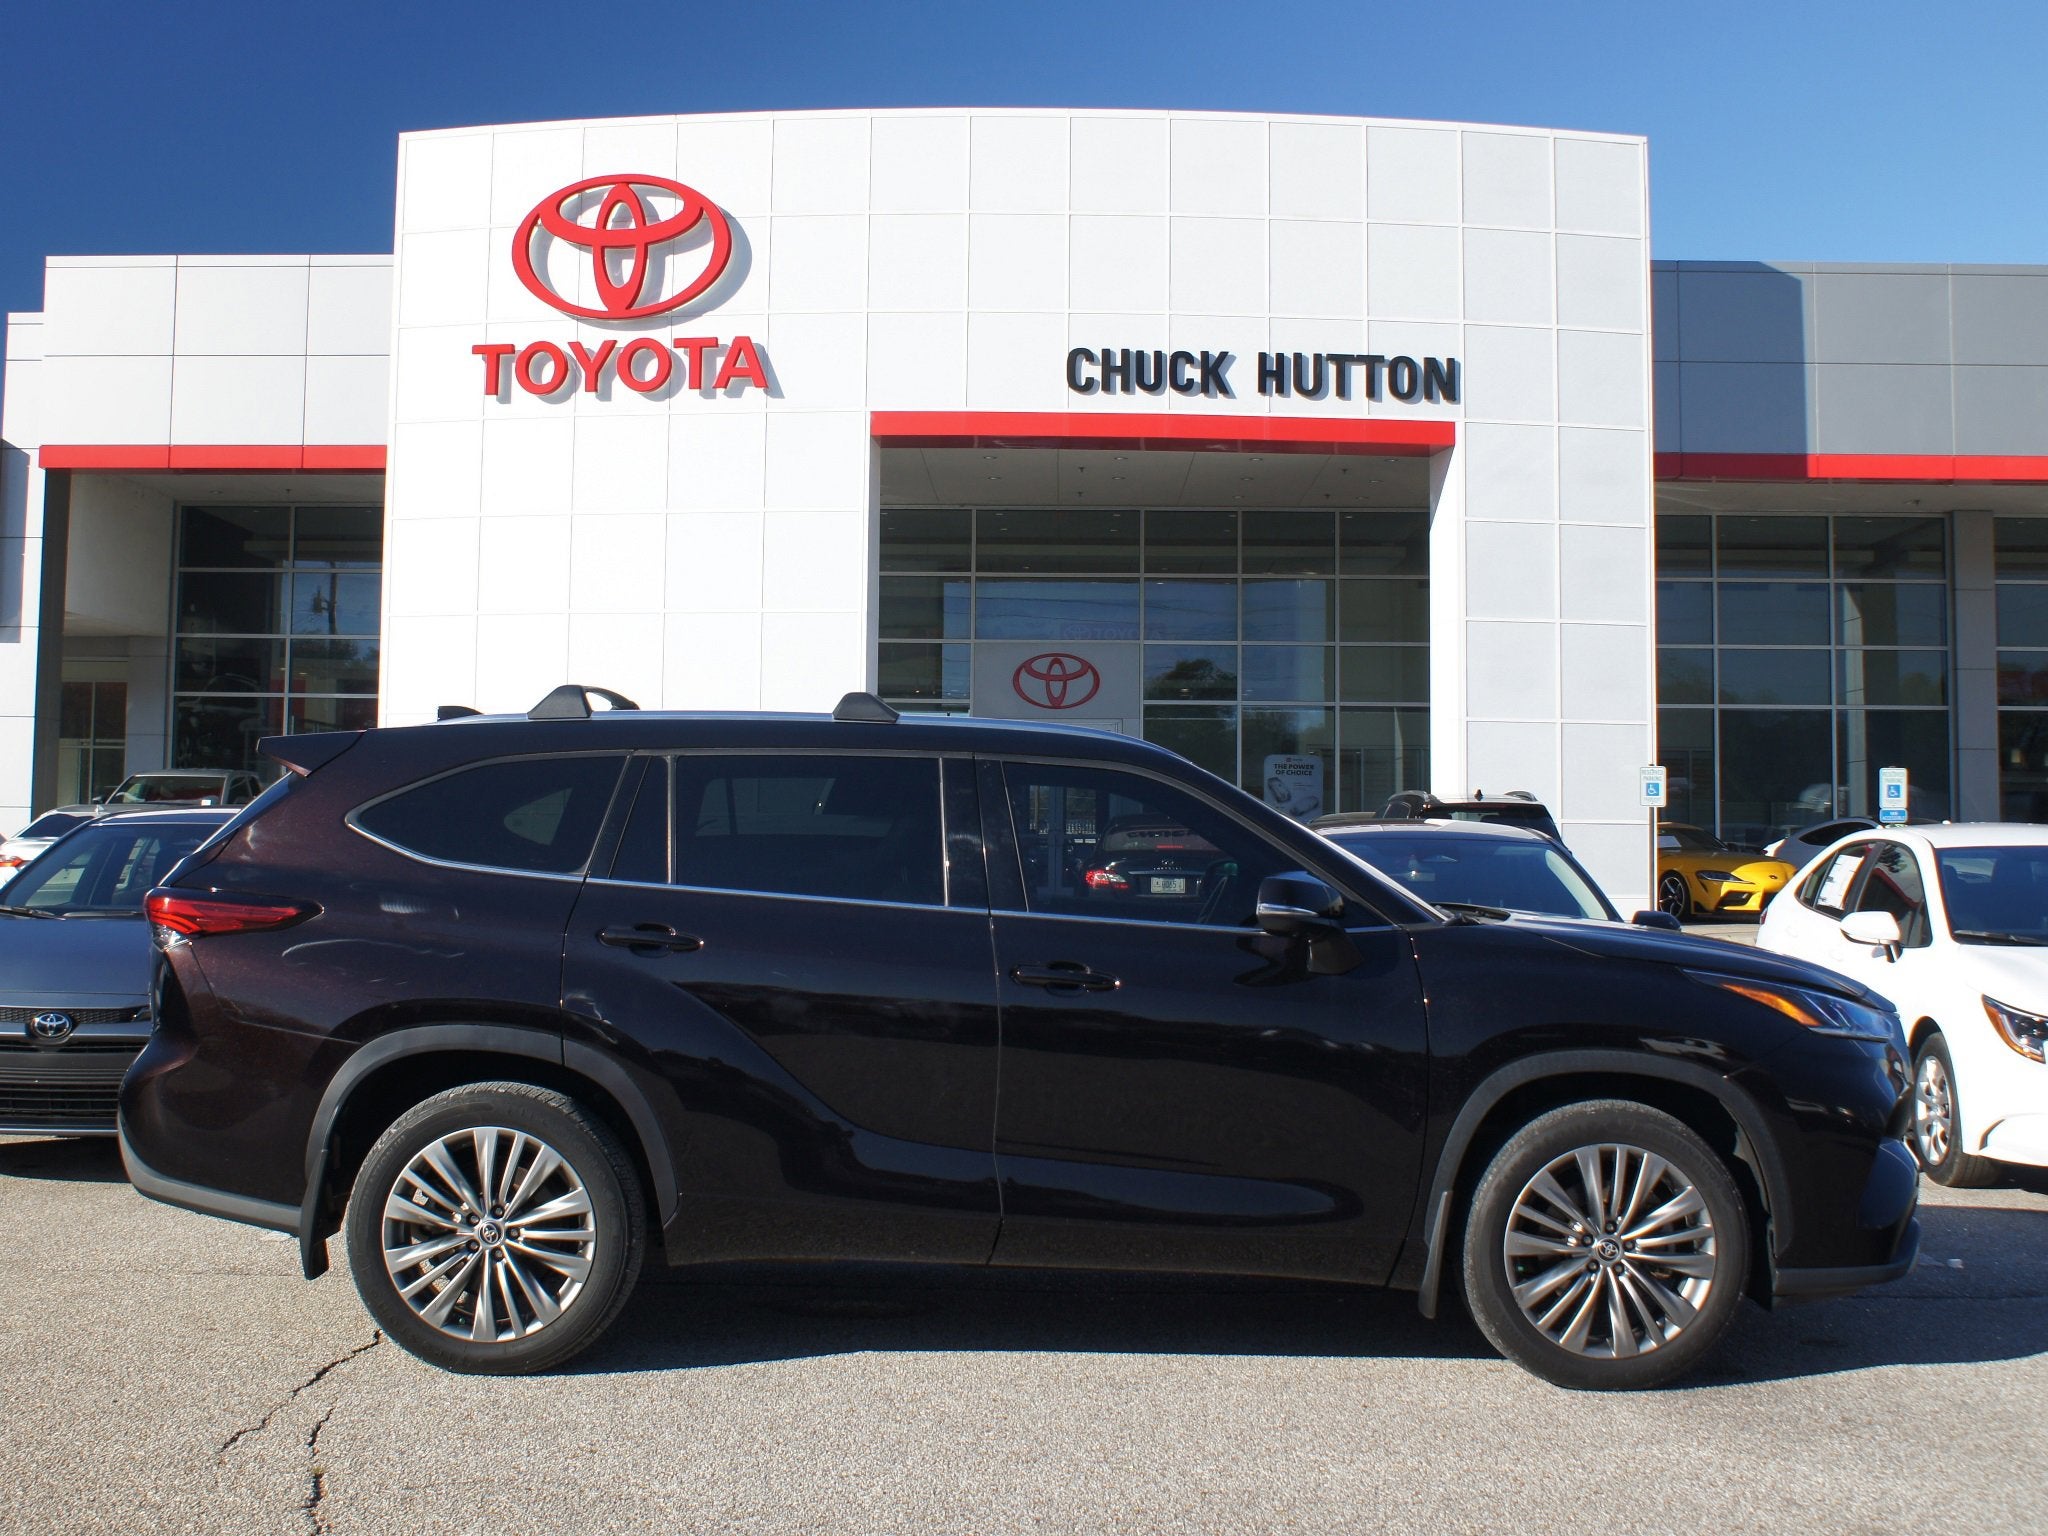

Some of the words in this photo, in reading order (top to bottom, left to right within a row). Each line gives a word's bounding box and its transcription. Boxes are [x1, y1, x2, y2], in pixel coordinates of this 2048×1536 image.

[472, 336, 768, 396] TOYOTA
[1066, 347, 1231, 394] CHUCK
[1257, 351, 1457, 402] HUTTON
